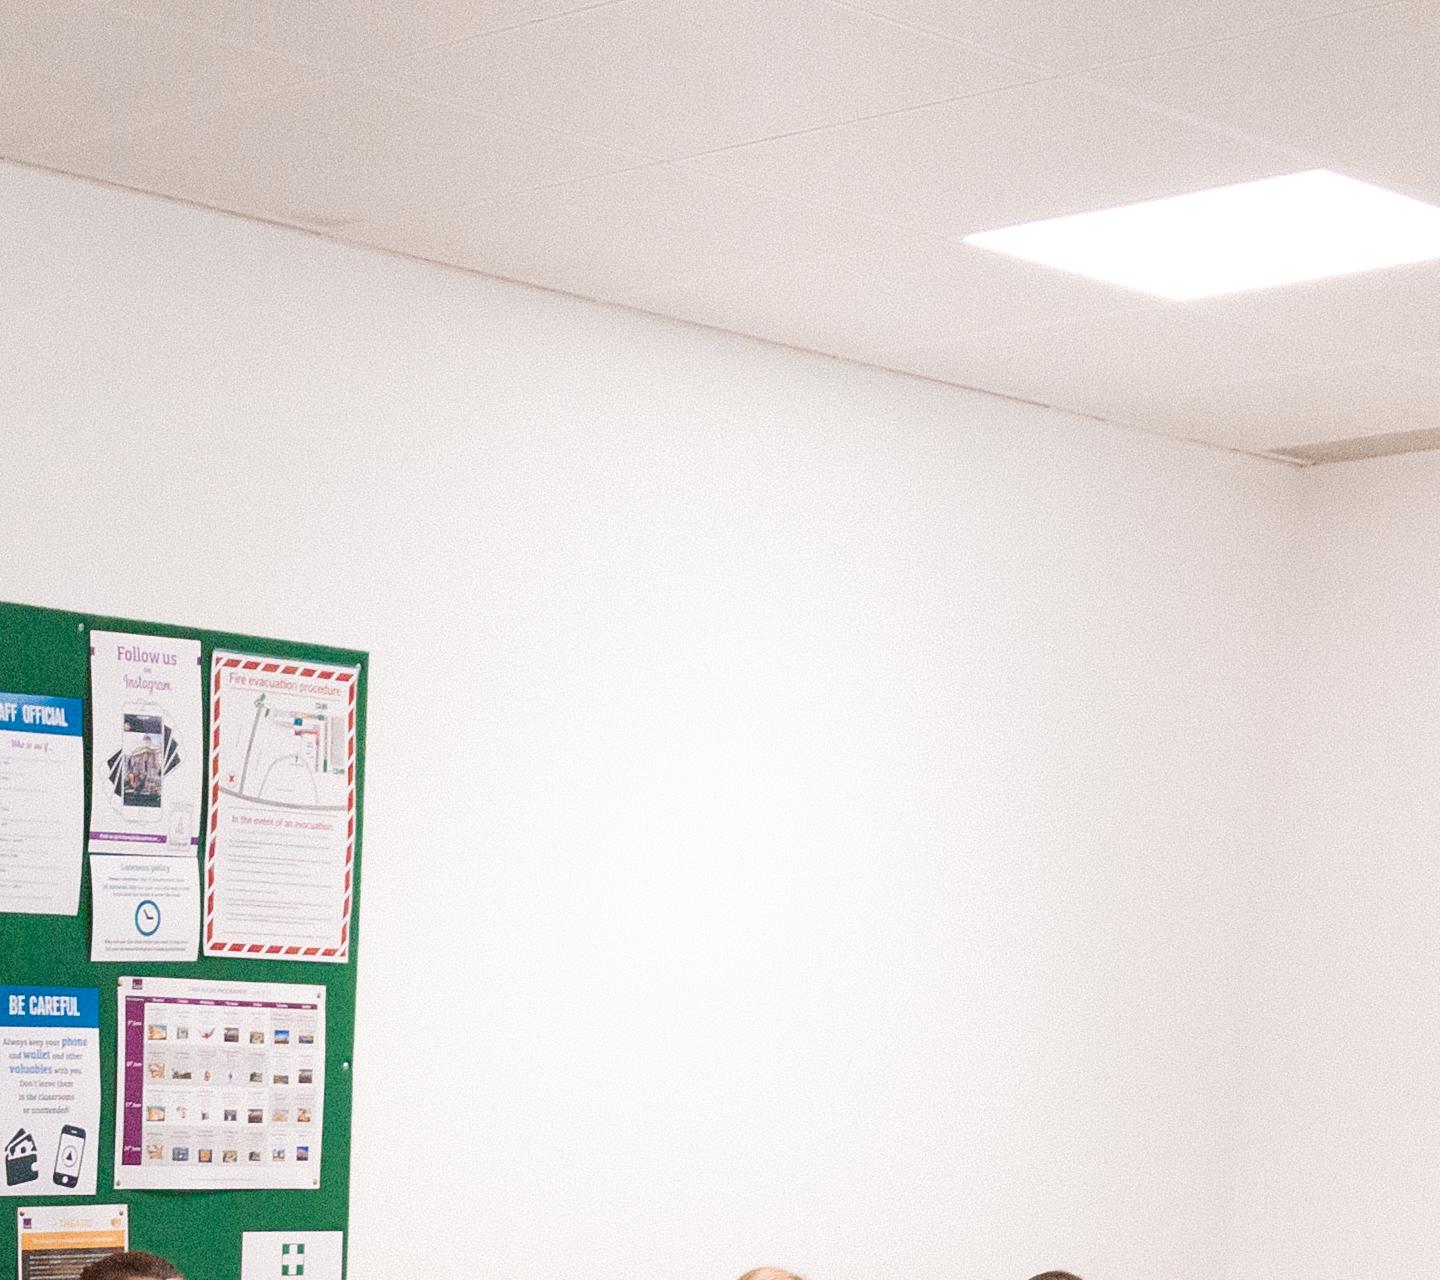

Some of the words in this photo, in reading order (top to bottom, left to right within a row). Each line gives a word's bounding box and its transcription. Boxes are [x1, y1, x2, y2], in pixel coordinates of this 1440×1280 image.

[117, 646, 160, 664] Follow
[163, 653, 177, 666] us
[123, 674, 172, 695] Instagram
[229, 672, 247, 685] Fire
[249, 677, 297, 691] evacuation
[299, 682, 341, 697] procedure
[22, 704, 68, 727] OFFICIAL
[9, 995, 26, 1015] BE
[29, 996, 80, 1016] CAREFUL
[3, 1038, 28, 1047] Always
[28, 1038, 44, 1048] keep
[61, 1037, 88, 1048] phone
[23, 1049, 51, 1059] wallet
[52, 1051, 64, 1059] and
[9, 1064, 52, 1074] valuables
